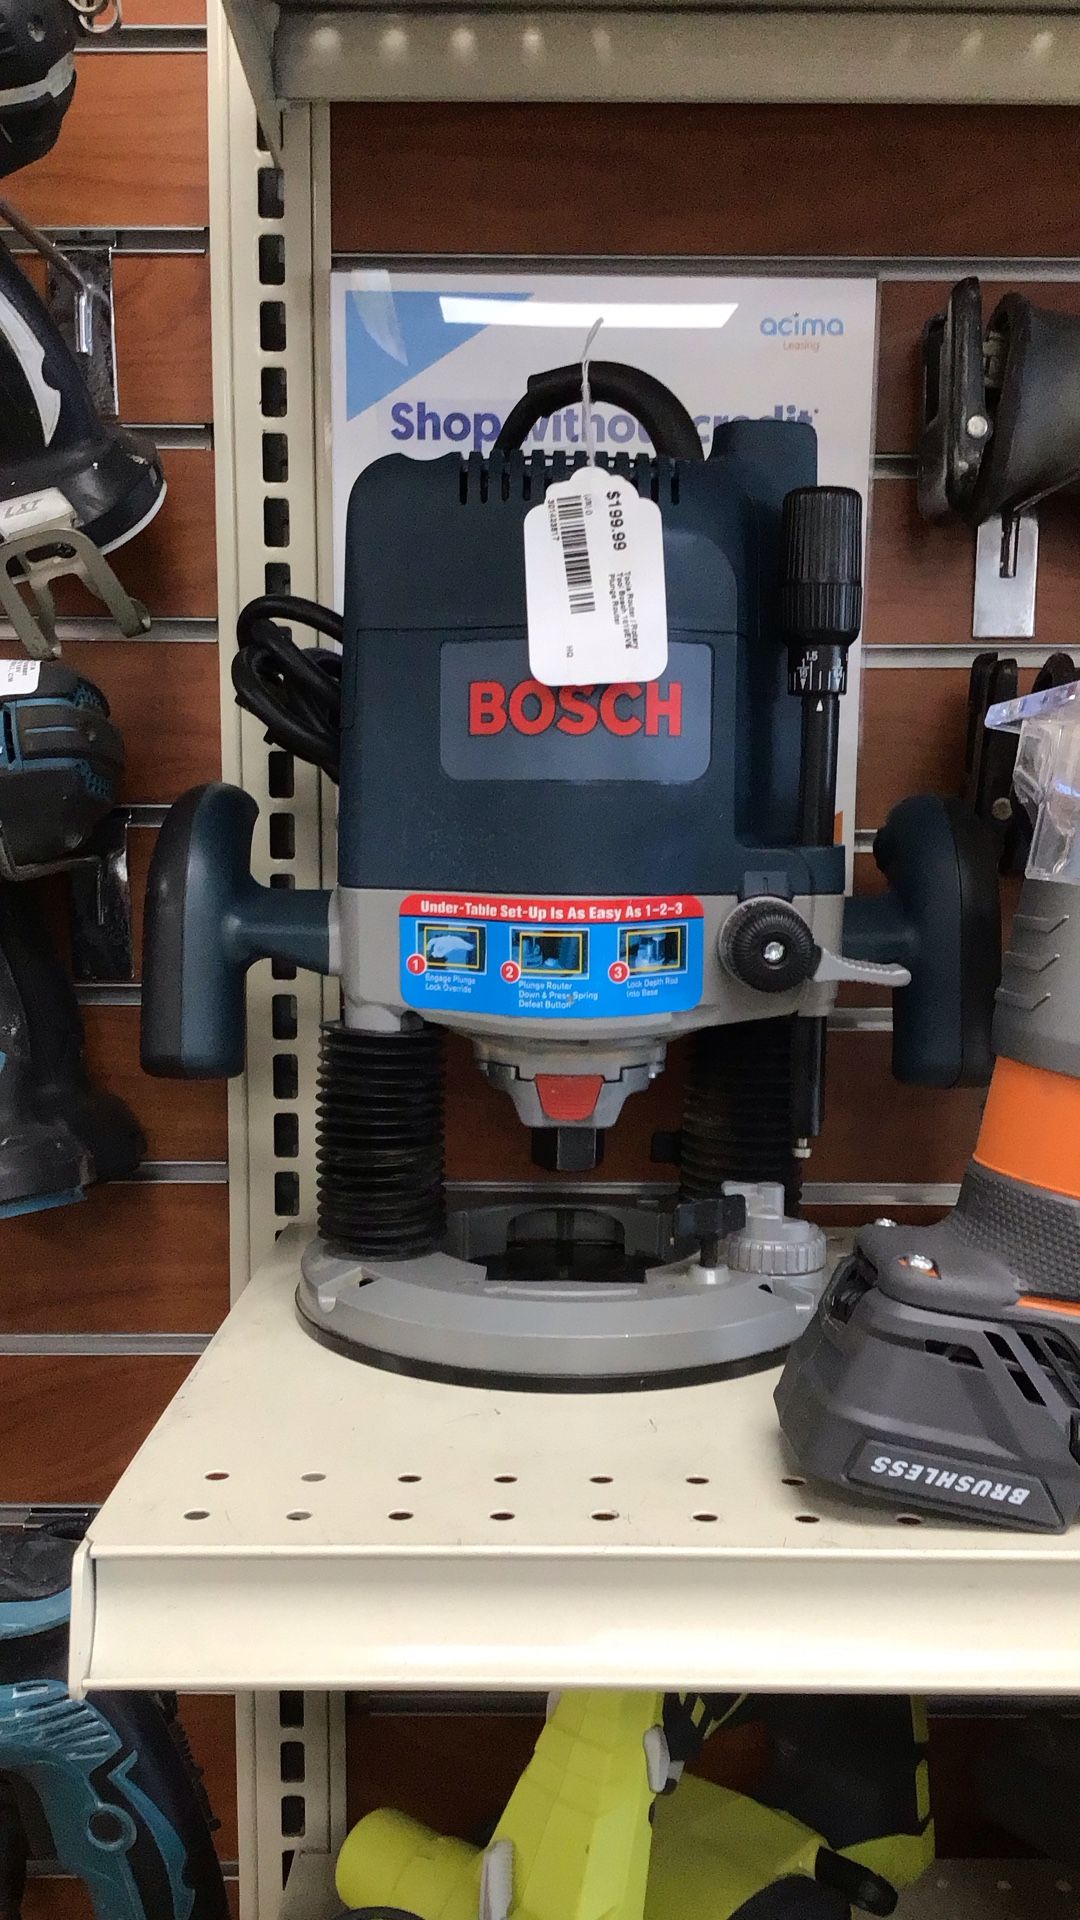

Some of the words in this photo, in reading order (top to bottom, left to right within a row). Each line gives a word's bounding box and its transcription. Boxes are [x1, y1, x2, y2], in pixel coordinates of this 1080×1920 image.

[760, 312, 844, 336] acima
[783, 340, 819, 353] Leasing
[391, 402, 501, 452] Shop
[524, 408, 653, 444] witho
[606, 490, 627, 551] $199.99
[806, 651, 818, 661] 1.5
[468, 679, 682, 737] BOSCH
[420, 900, 498, 917] Under-Table
[501, 905, 547, 921] Set-Up
[551, 907, 564, 919] Is
[567, 906, 586, 919] As
[589, 906, 622, 922] Easy
[625, 905, 642, 918] As
[645, 902, 683, 916] 1-2-3
[506, 966, 514, 978] 2
[613, 966, 622, 979] 3
[425, 973, 450, 983] Engage
[452, 974, 476, 985] Plunge
[627, 979, 642, 988] Lock
[644, 977, 664, 987] Depth
[665, 977, 679, 985] Rod
[425, 983, 441, 991] Lock
[443, 983, 472, 993] Override
[519, 981, 545, 990] Plunge
[546, 981, 572, 990] Router
[518, 990, 540, 999] Down
[542, 991, 547, 999] &
[573, 991, 599, 1001] Spring
[642, 988, 659, 997] Base
[518, 999, 543, 1008] Defeat
[545, 1000, 572, 1009] Button
[870, 1456, 1031, 1506] BRUSHLESS
